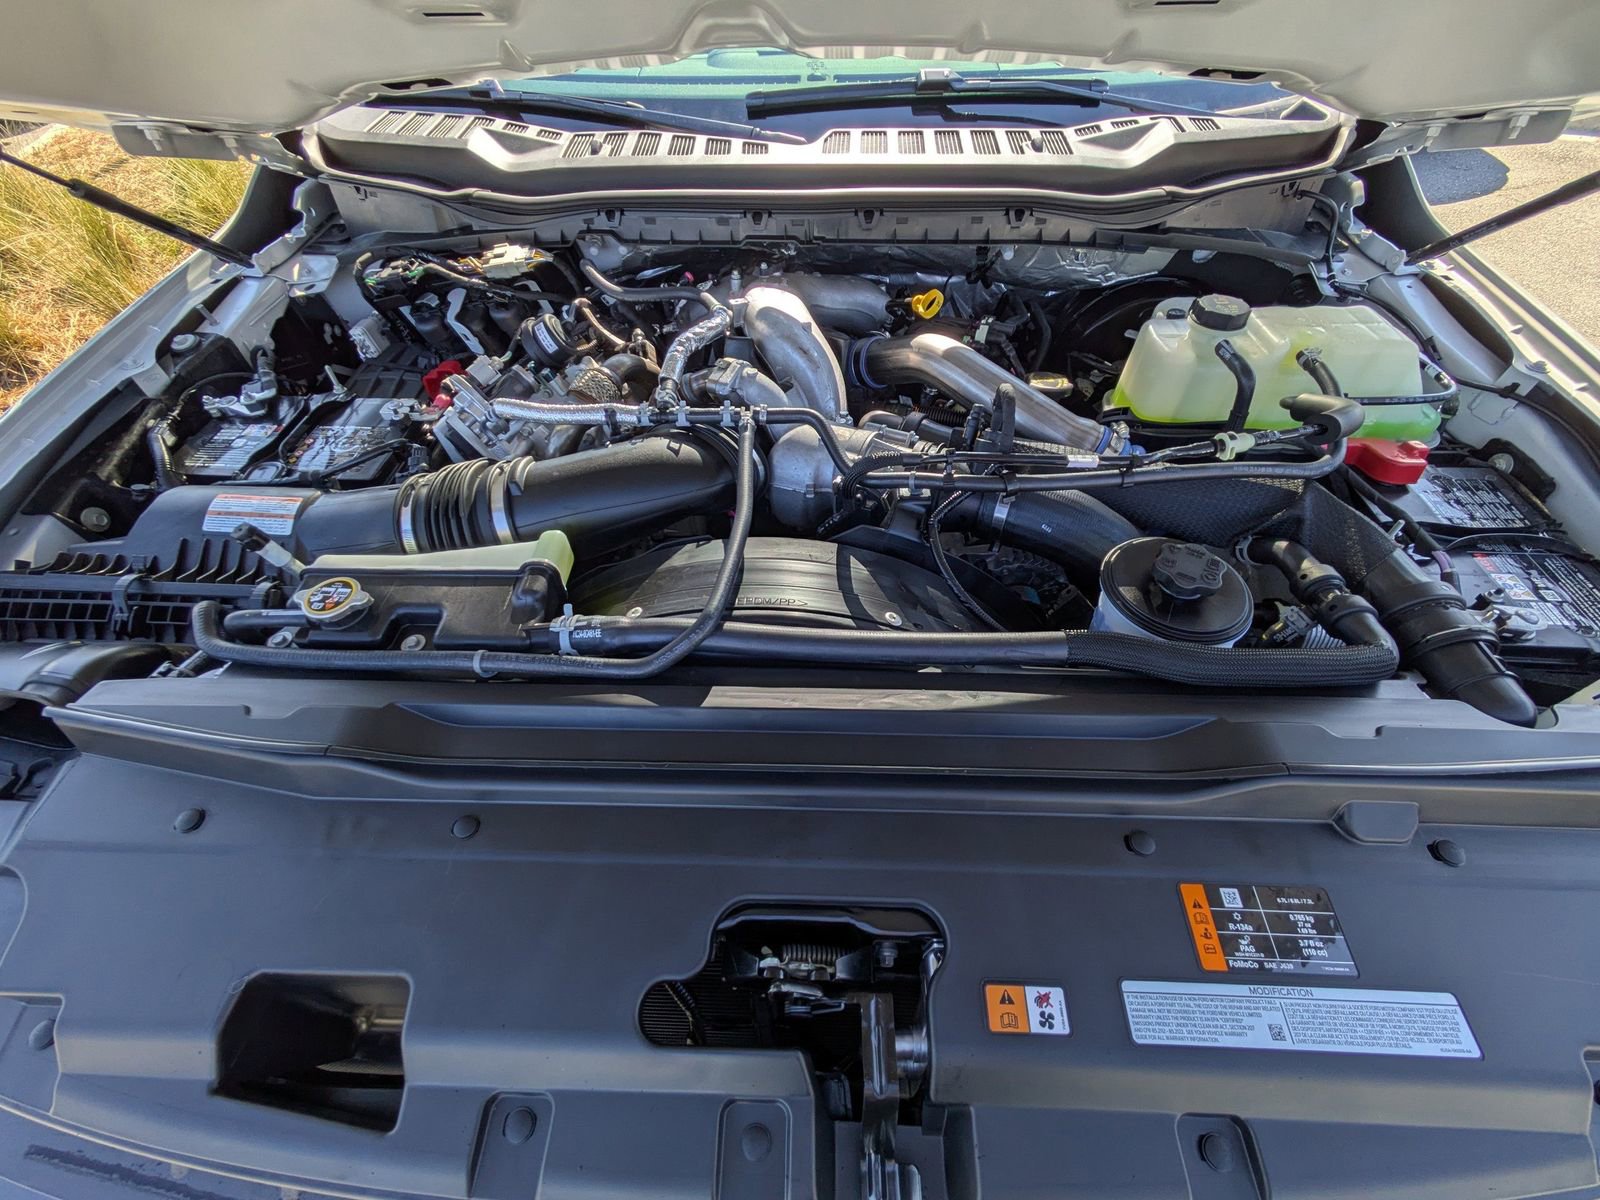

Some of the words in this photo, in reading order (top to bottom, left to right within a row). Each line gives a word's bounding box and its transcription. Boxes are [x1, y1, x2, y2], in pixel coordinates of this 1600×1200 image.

[1229, 922, 1254, 931] R-134a
[1240, 944, 1256, 952] PAG
[1302, 948, 1316, 956] (110
[1317, 949, 1328, 958] cc)
[1228, 960, 1259, 968] FoMoCo
[1248, 986, 1314, 998] MODIFICATION
